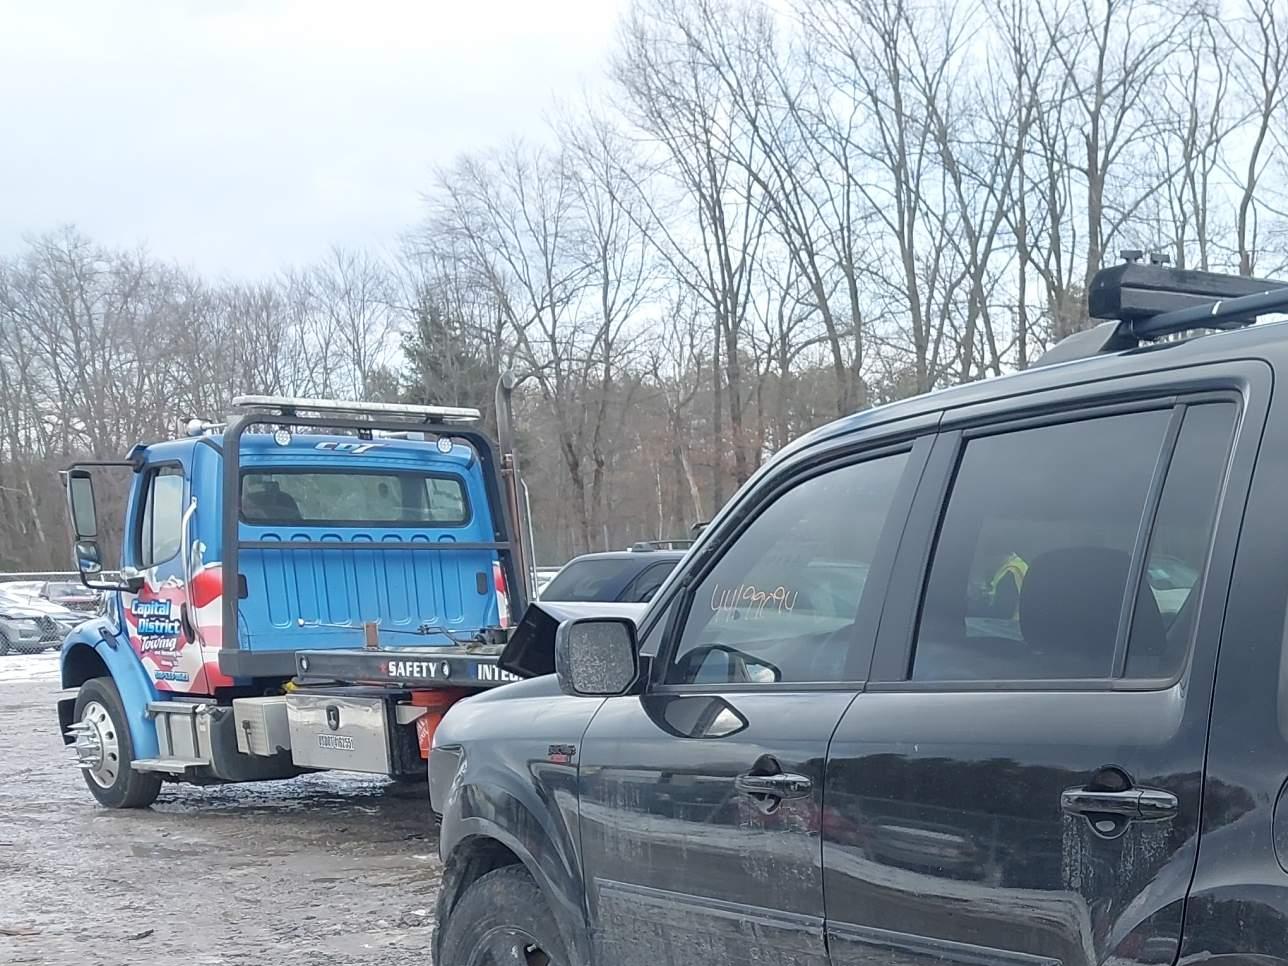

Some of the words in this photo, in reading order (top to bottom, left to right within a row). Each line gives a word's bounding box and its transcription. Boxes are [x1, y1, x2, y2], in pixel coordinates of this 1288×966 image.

[131, 599, 171, 618] Capital
[138, 618, 181, 634] District
[141, 634, 177, 652] Towing
[388, 661, 437, 677] SAFETY
